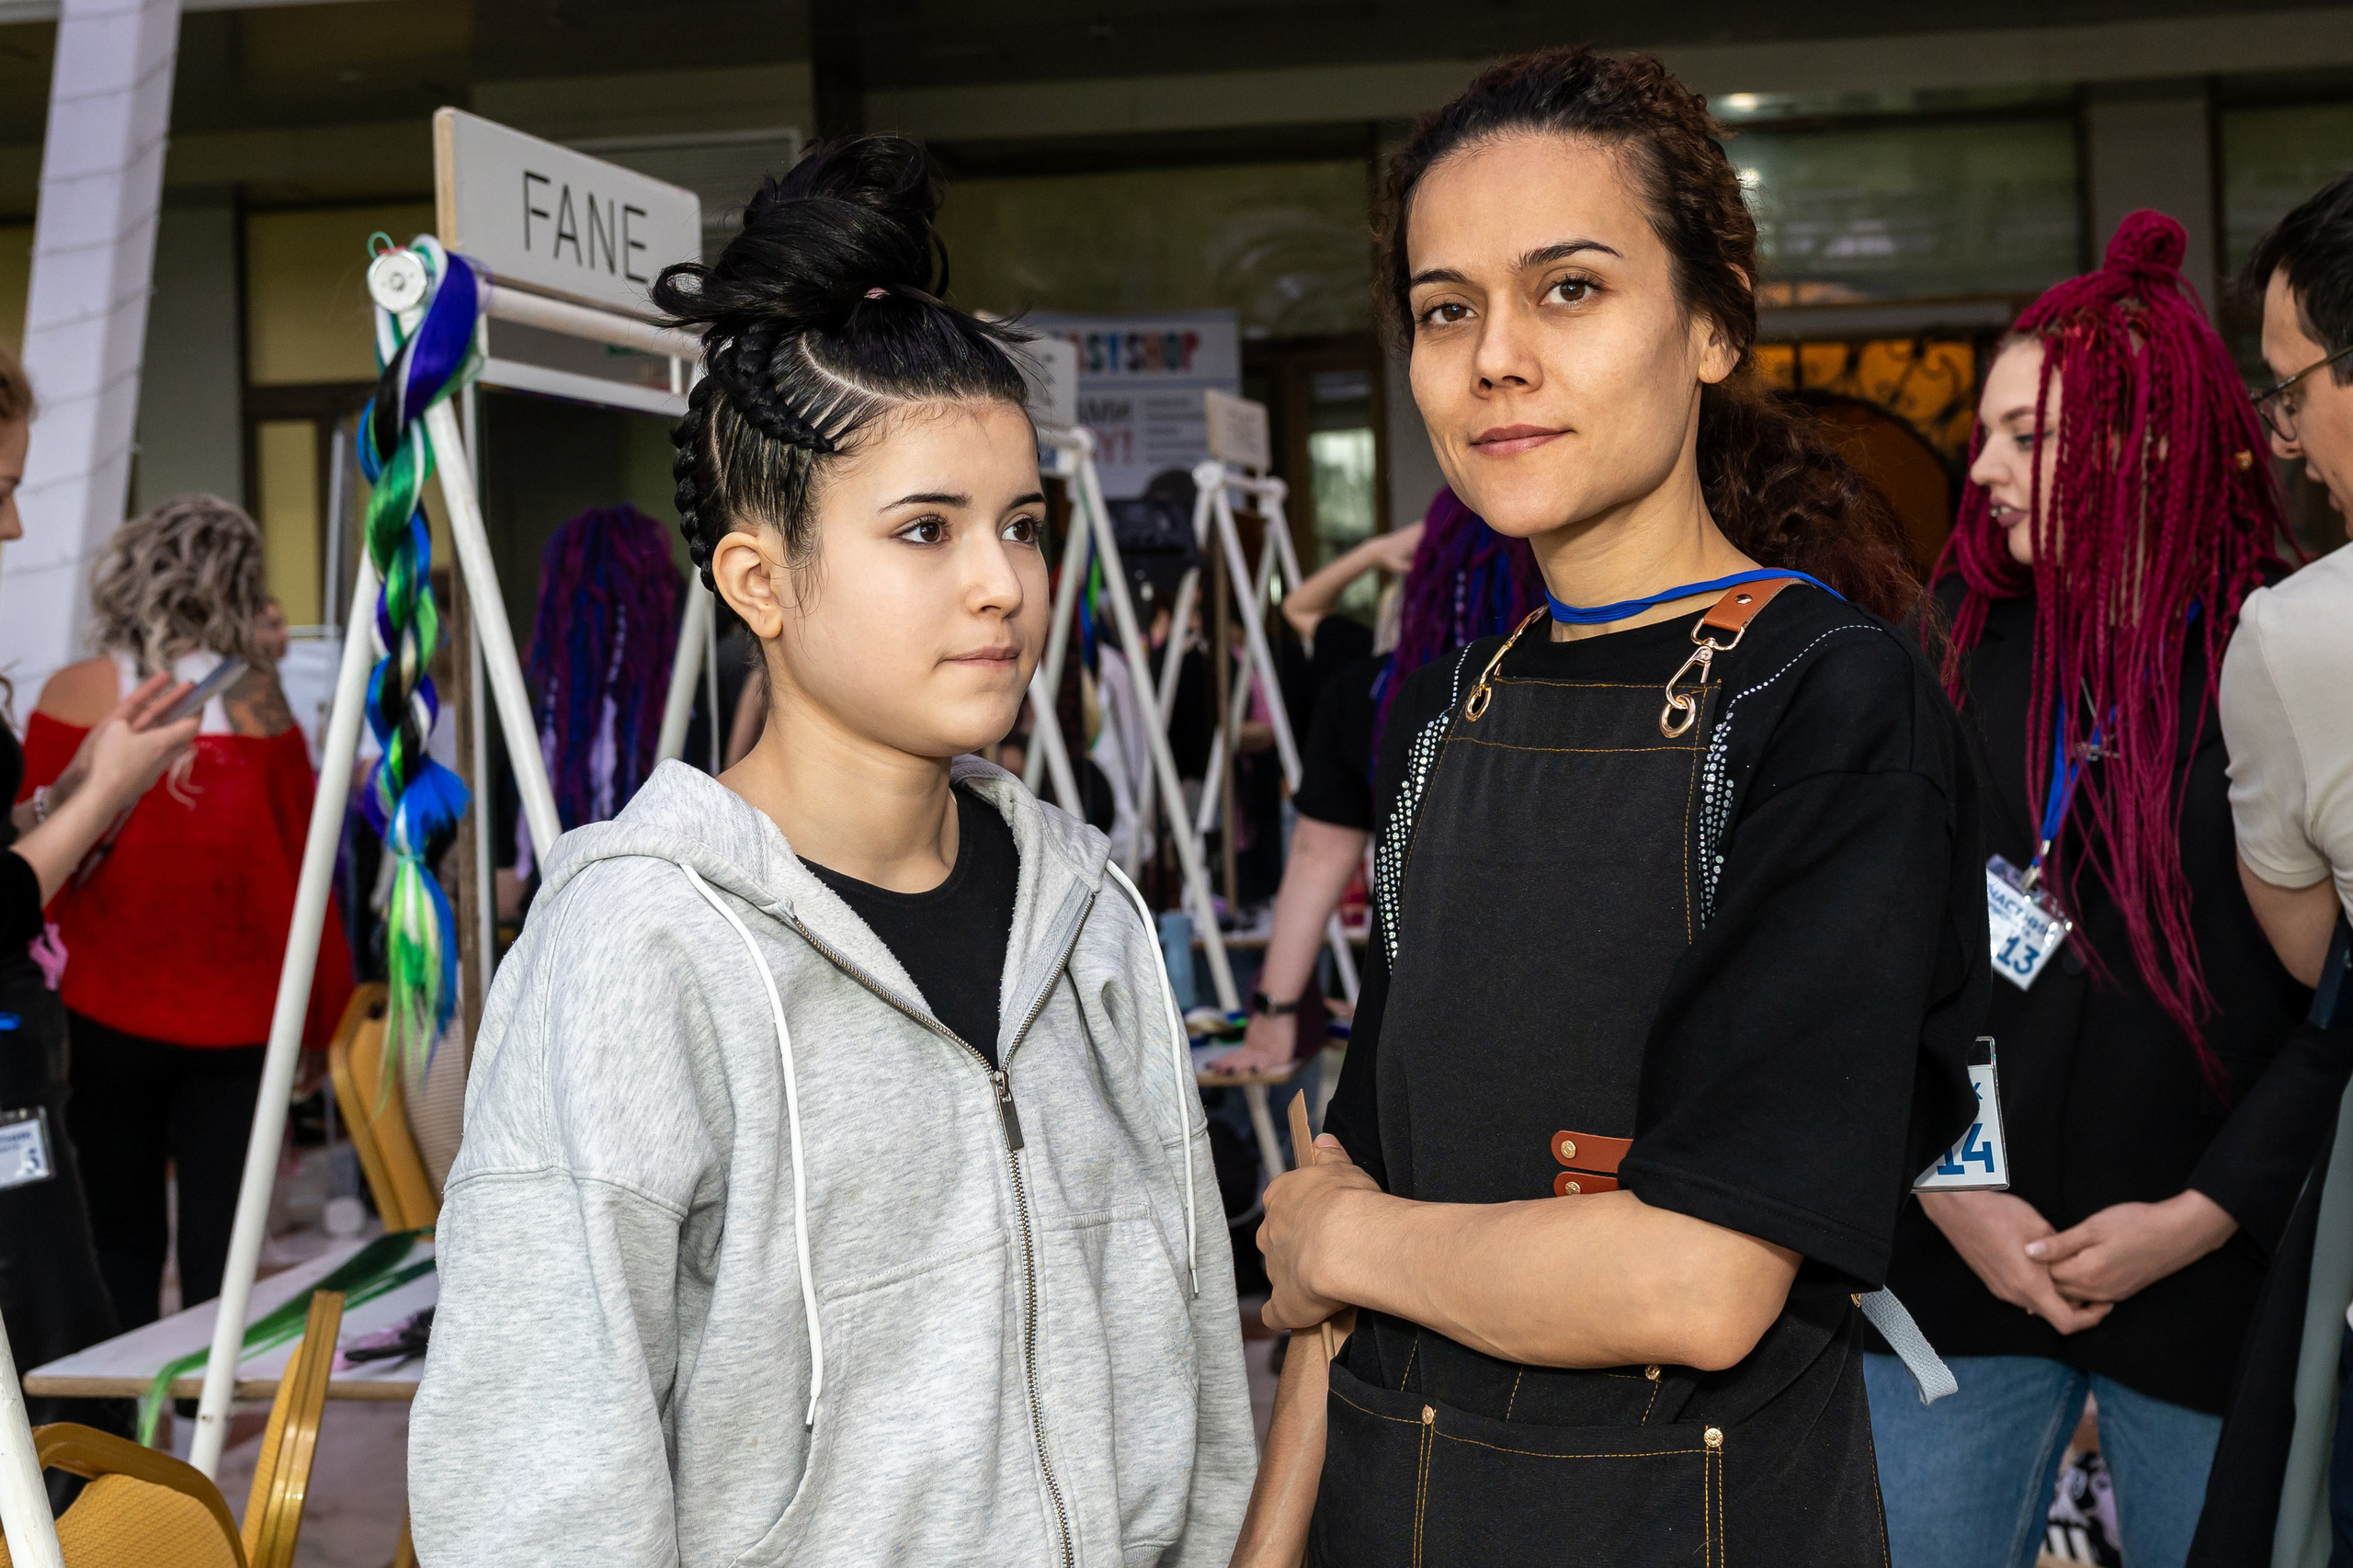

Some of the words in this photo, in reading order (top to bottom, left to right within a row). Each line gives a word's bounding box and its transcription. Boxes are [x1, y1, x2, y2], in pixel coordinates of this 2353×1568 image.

[523, 169, 647, 283] FANE
[1995, 936, 2040, 976] 13
[1937, 1122, 1995, 1176] 14
